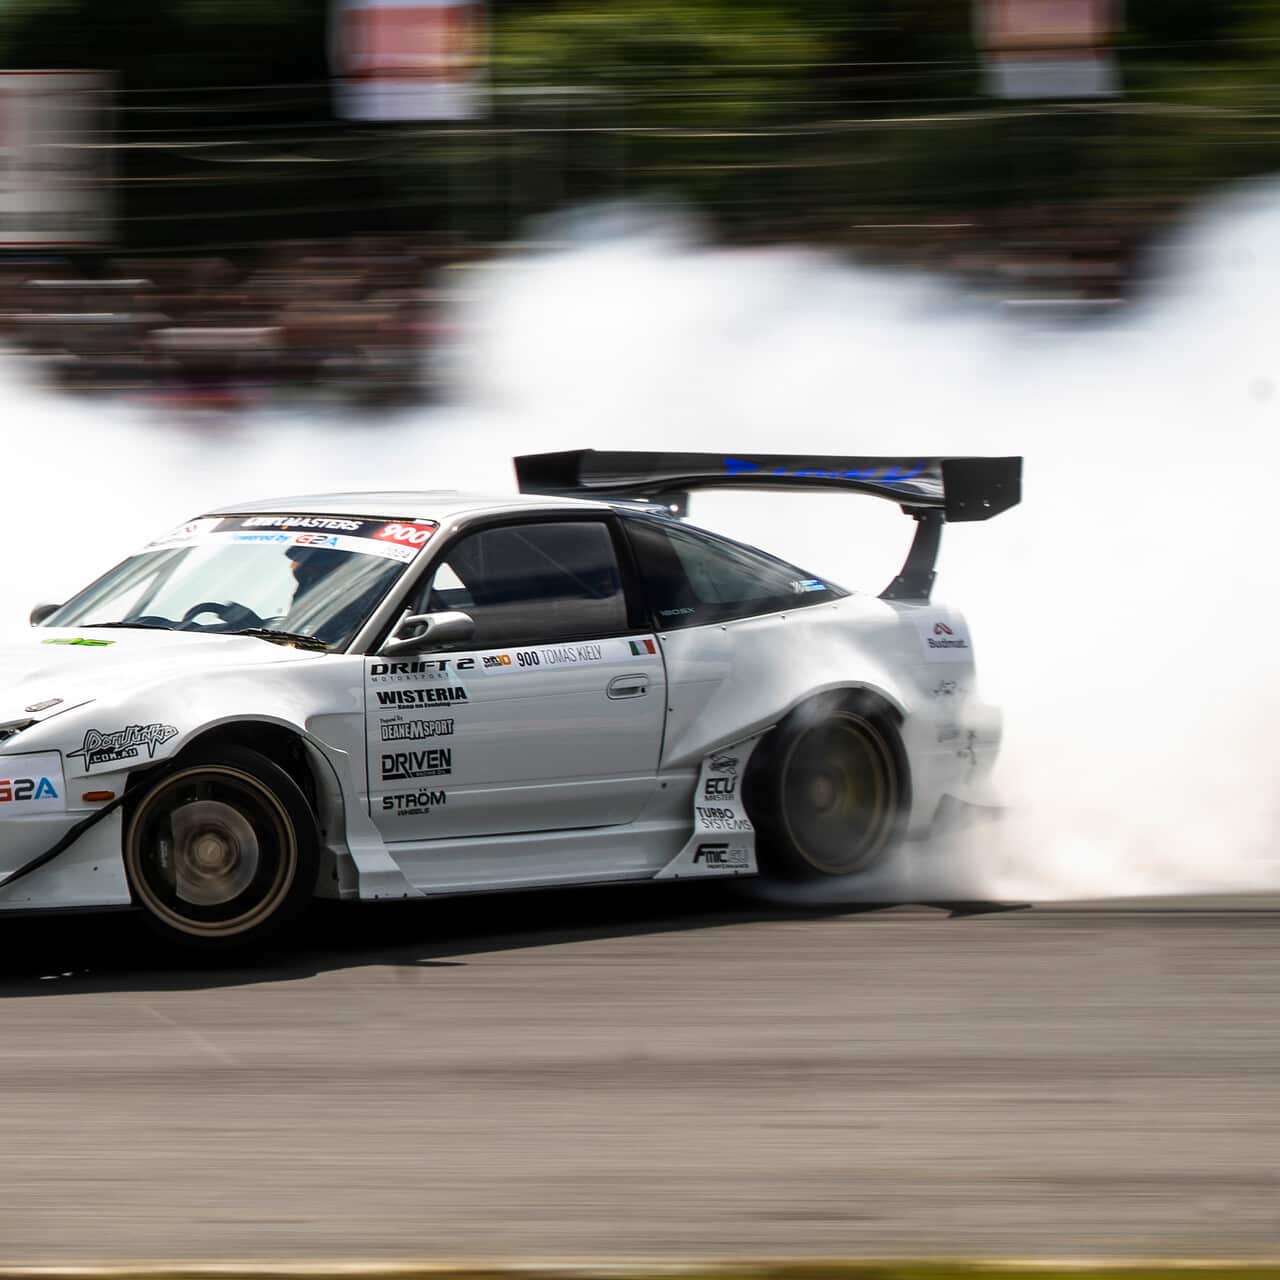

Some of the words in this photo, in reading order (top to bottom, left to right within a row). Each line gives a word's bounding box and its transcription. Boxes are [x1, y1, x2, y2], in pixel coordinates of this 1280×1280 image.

[295, 534, 338, 547] G2A
[381, 523, 432, 544] 900
[516, 652, 540, 667] 900
[541, 647, 577, 664] TOMAS
[577, 644, 601, 662] KIELY
[370, 659, 451, 676] DRIFT
[457, 658, 475, 670] 2
[376, 686, 468, 705] WISTERIA
[382, 748, 451, 775] DRIVEN
[704, 776, 738, 795] ECU
[382, 788, 446, 811] STRÖM
[696, 806, 735, 819] TURBO
[701, 818, 752, 830] SYSTEMS
